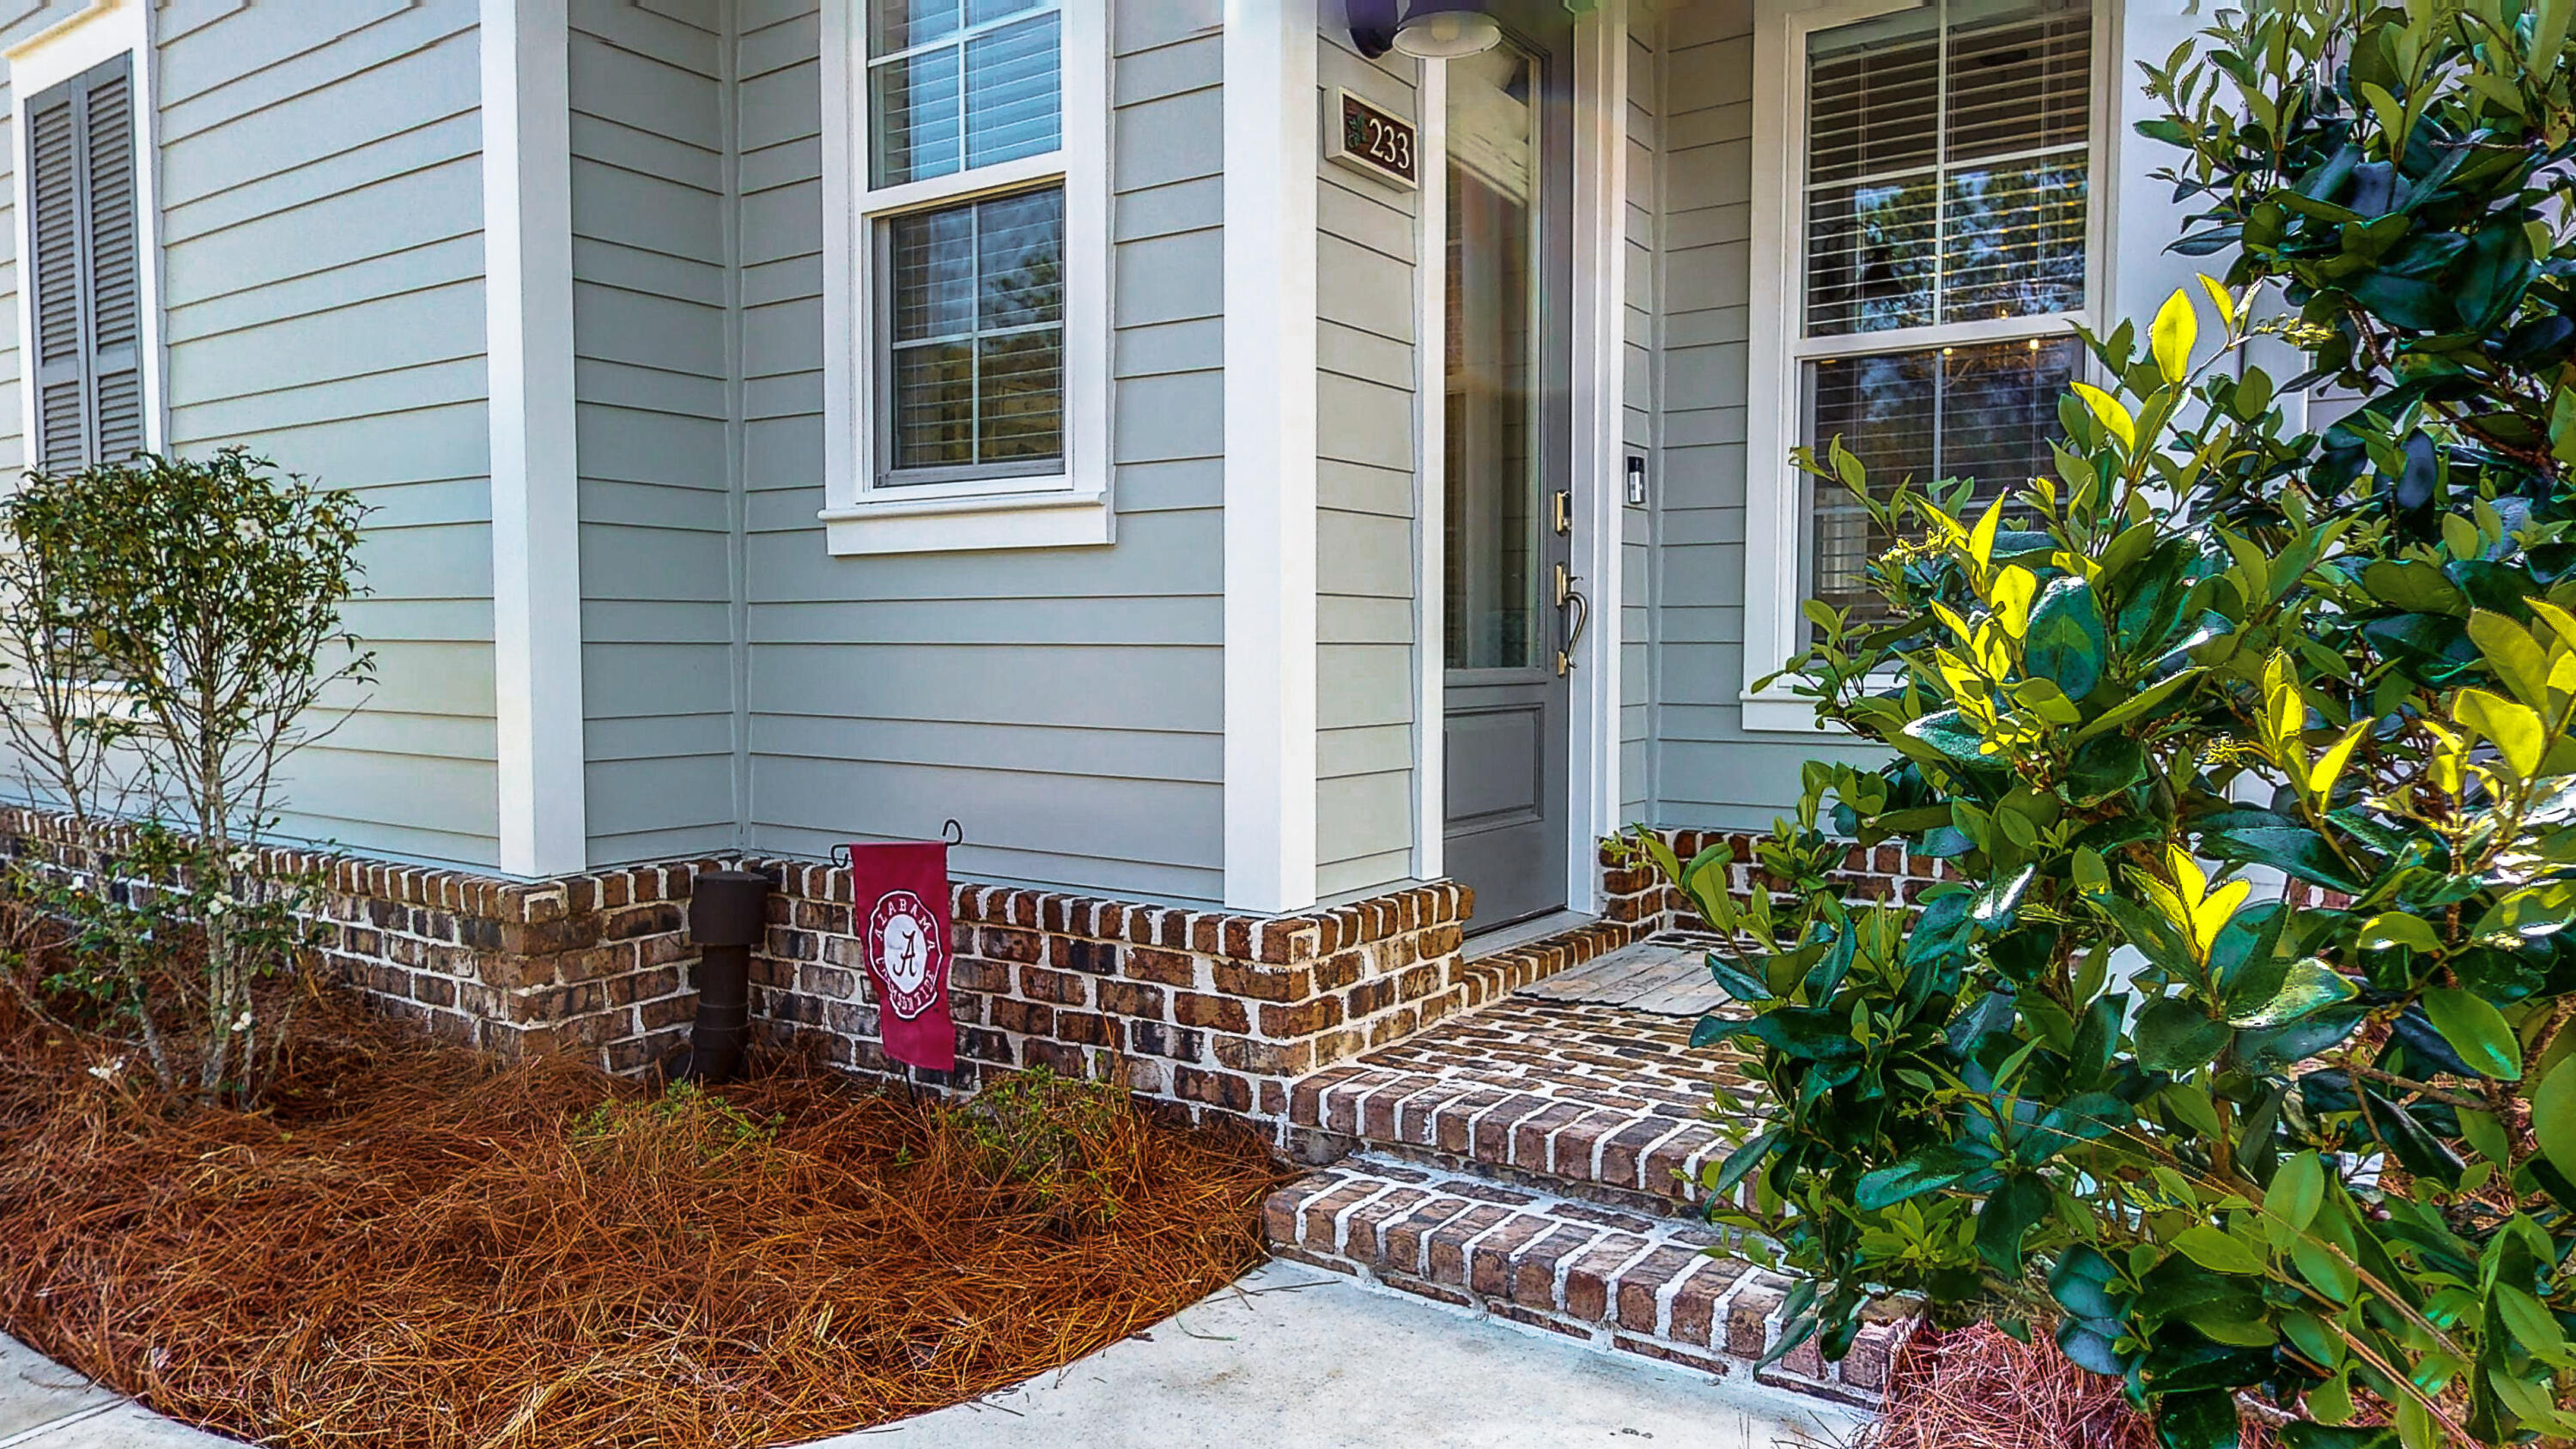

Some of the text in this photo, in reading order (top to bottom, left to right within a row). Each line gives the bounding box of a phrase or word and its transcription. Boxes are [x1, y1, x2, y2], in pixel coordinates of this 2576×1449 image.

[1369, 118, 1410, 169] 233
[874, 898, 936, 952] ALABAMA
[893, 931, 917, 977] A
